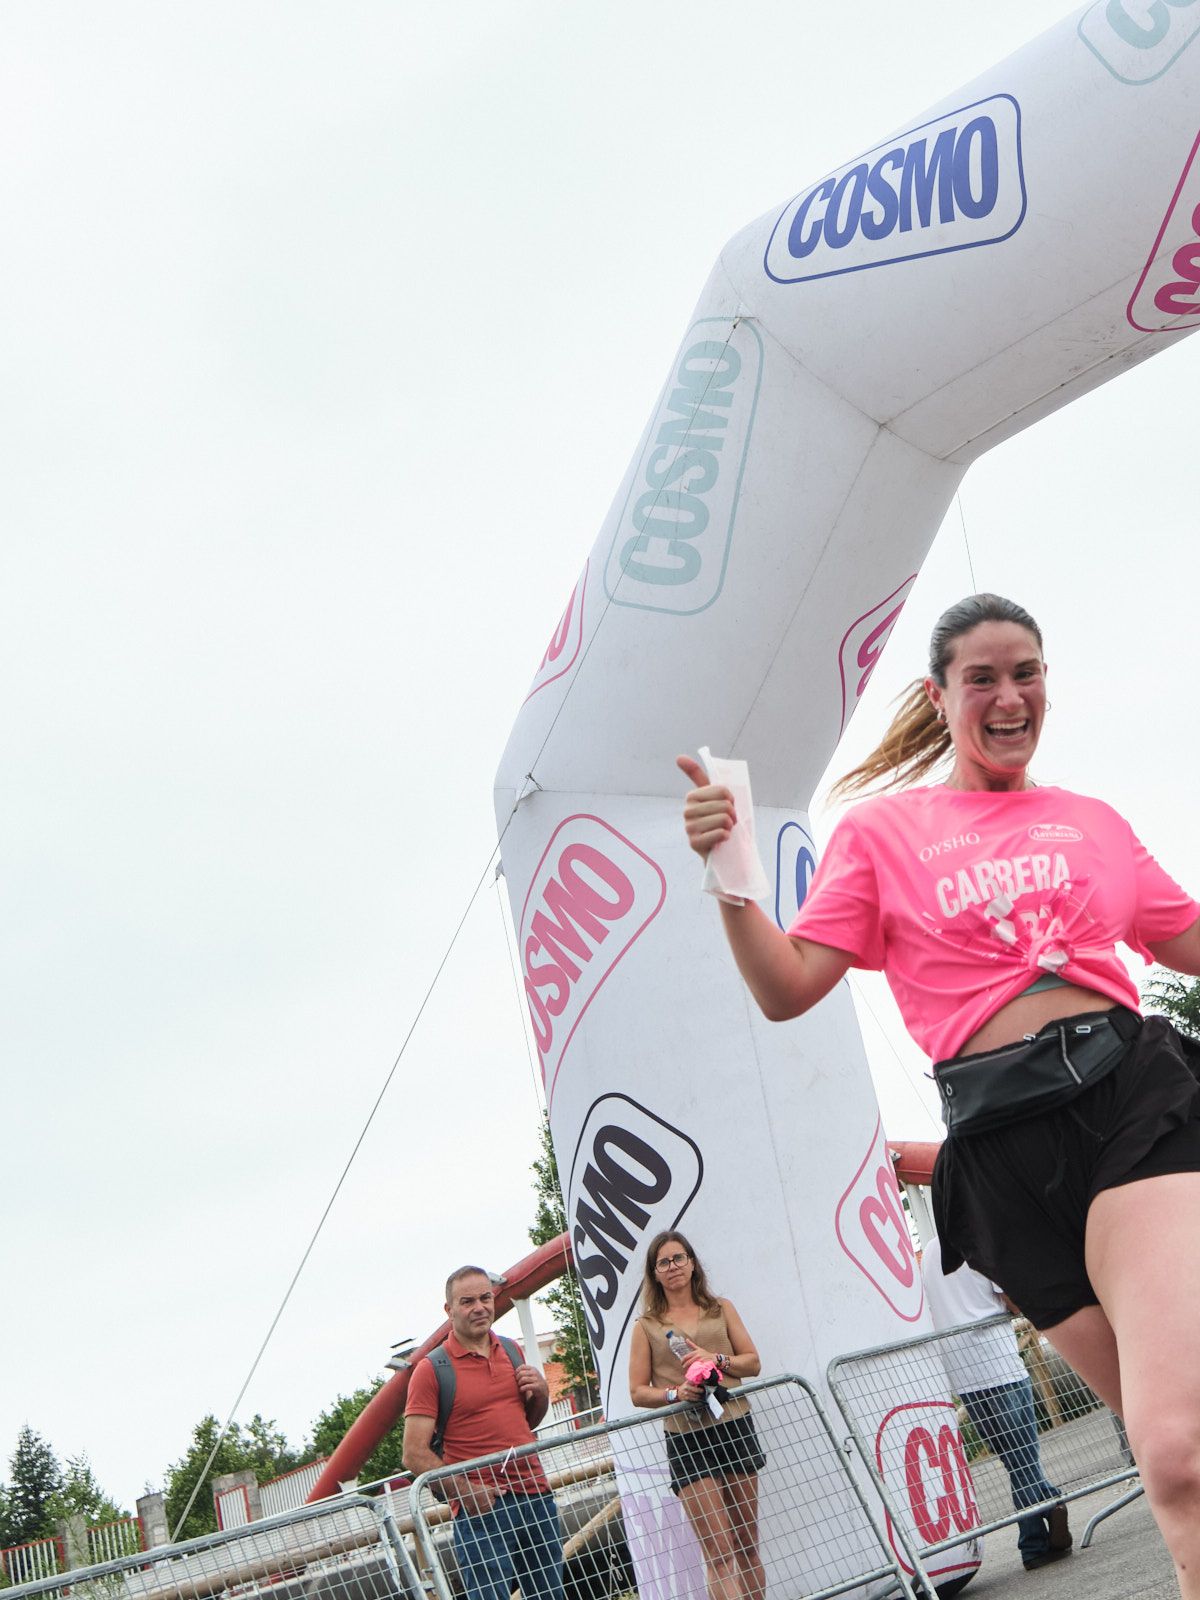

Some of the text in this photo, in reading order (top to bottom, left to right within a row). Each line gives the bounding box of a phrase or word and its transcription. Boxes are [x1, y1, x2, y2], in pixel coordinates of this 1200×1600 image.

[788, 115, 999, 259] COSMO
[619, 340, 742, 586] COSMO
[919, 832, 980, 863] OYSHO
[936, 852, 1072, 919] CARRERA
[523, 843, 635, 1090] OSMO
